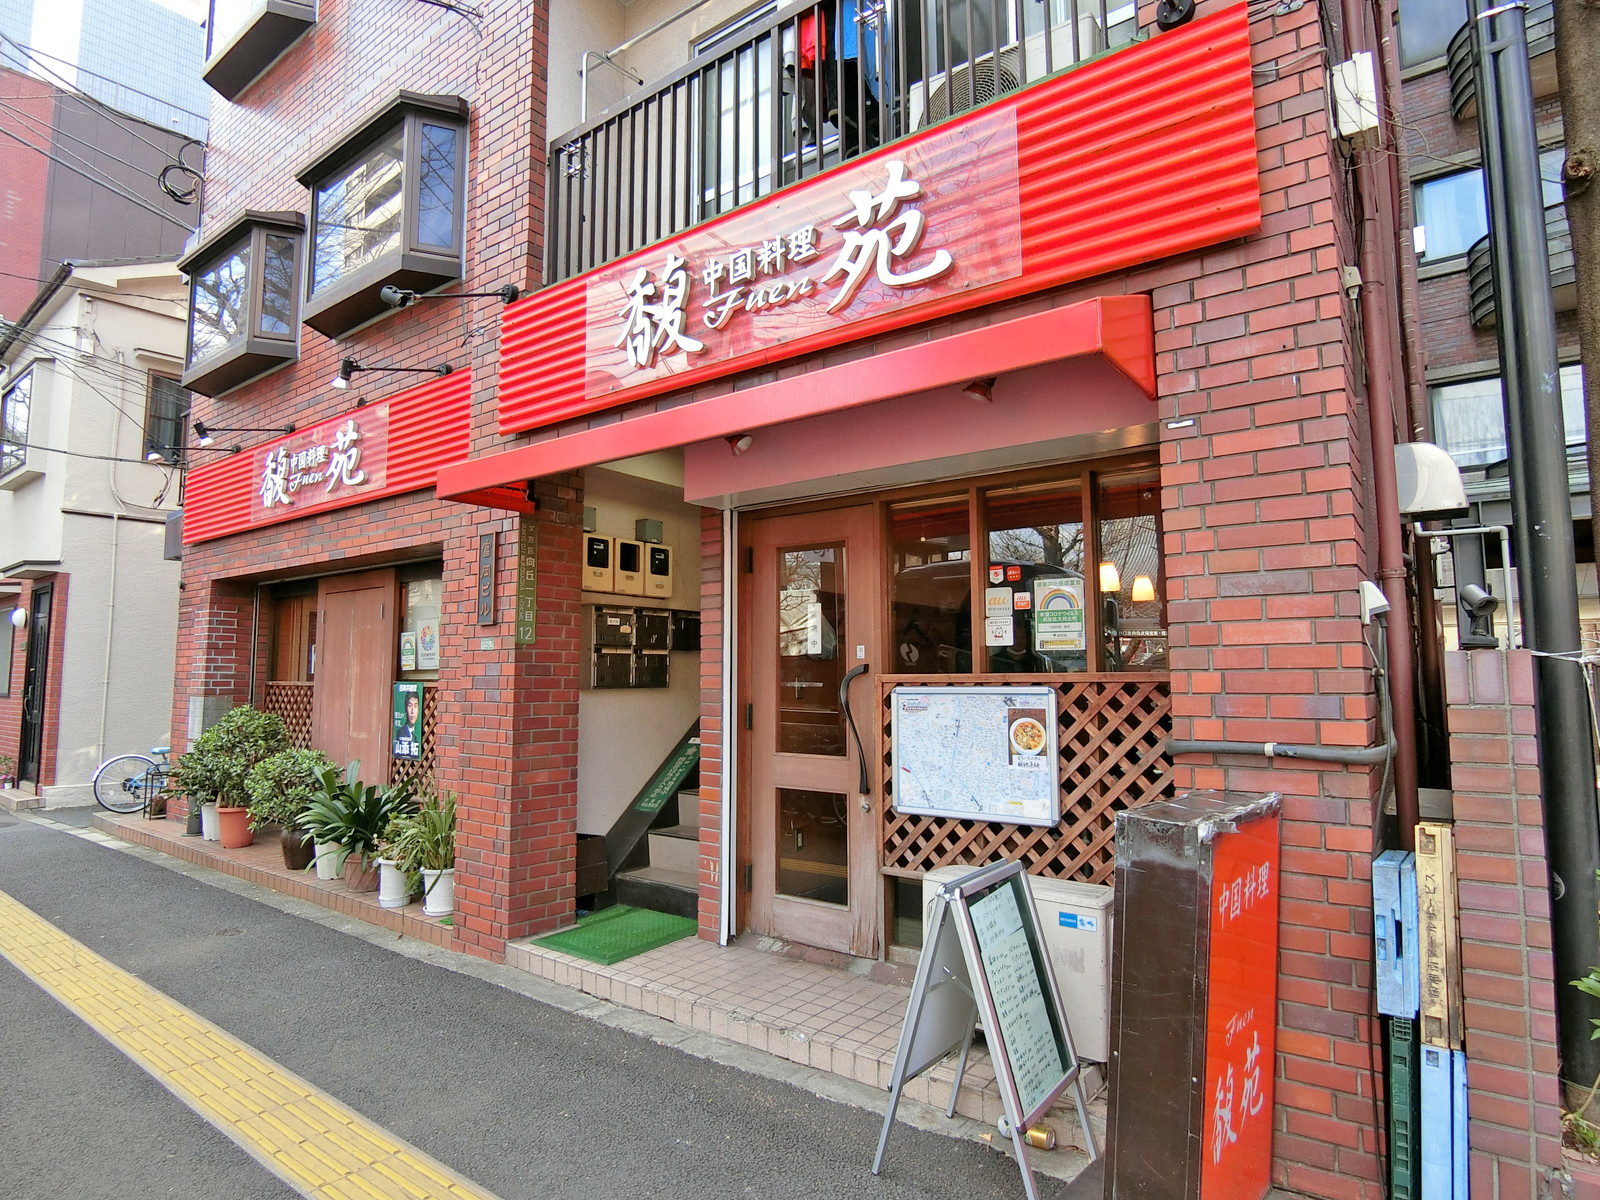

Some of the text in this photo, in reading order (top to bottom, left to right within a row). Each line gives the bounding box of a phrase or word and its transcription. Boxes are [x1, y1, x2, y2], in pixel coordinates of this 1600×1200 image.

[702, 224, 820, 297] 中国料理
[822, 161, 955, 314] 苑
[701, 276, 817, 330] Fuen
[289, 444, 330, 472] 中国料理
[325, 420, 366, 493] 苑
[289, 470, 324, 492] Fuen
[988, 596, 1009, 606] au
[519, 626, 533, 640] 12
[1218, 860, 1270, 931] 中国料理
[1225, 1008, 1254, 1048] Fuen
